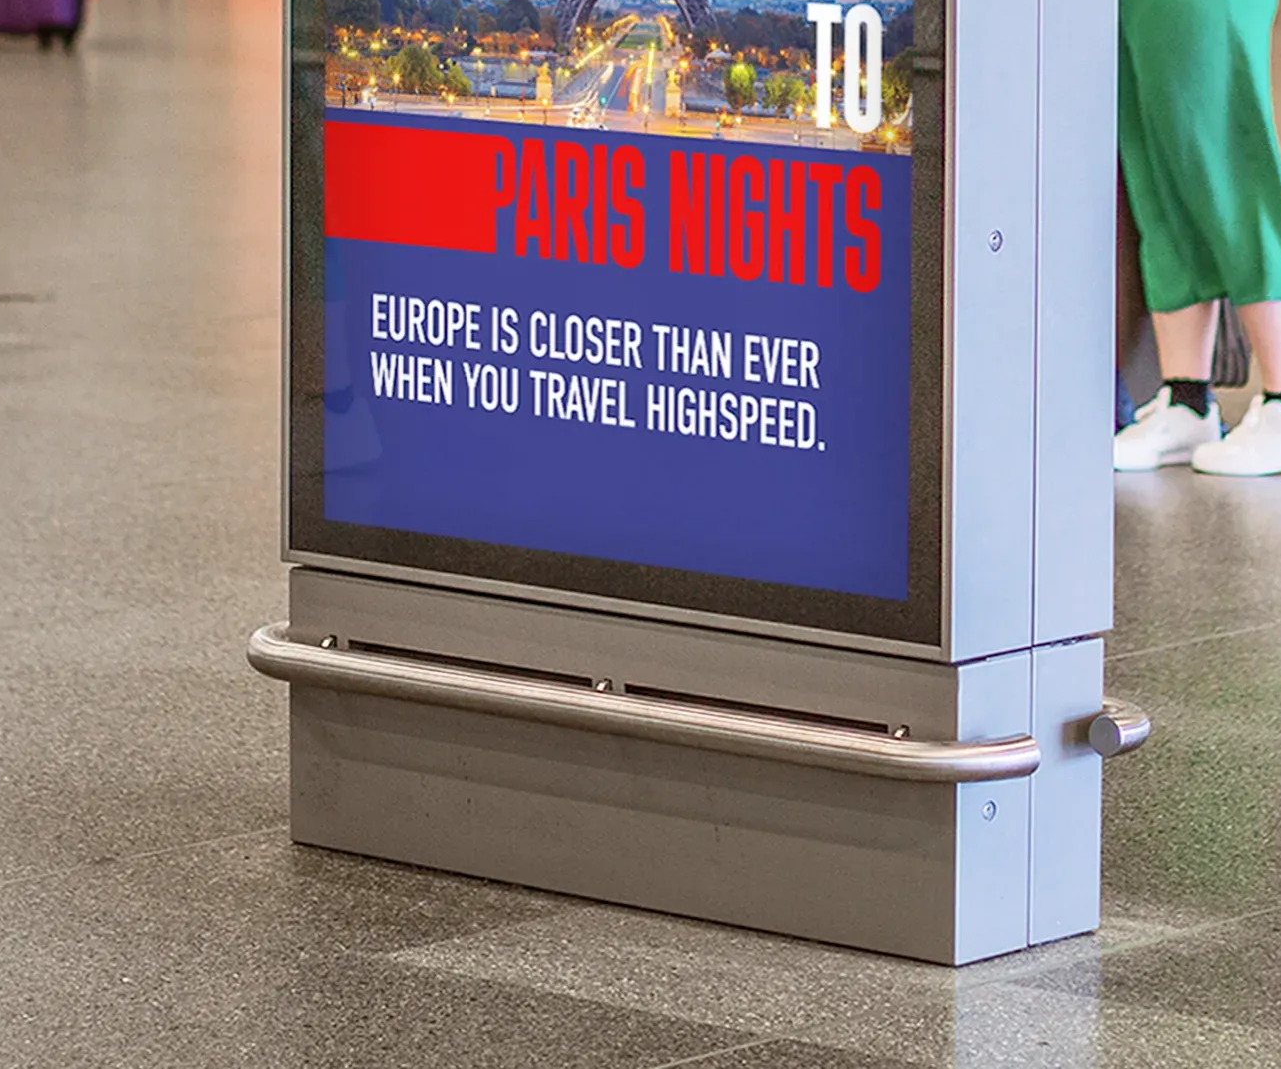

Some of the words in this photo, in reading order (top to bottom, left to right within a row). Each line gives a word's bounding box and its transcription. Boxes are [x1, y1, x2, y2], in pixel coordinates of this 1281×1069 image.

[807, 2, 884, 134] TO
[484, 132, 646, 270] PARIS
[668, 149, 883, 294] NIGHTS
[372, 293, 482, 351] EUROPE
[491, 306, 519, 355] IS
[529, 310, 643, 369] CLOSER
[651, 323, 732, 379] THAN
[743, 334, 820, 390] EVER
[370, 350, 453, 406] WHEN
[462, 361, 519, 414] YOU
[528, 369, 636, 429] TRAVEL
[646, 383, 826, 452] HIGHSPEED.
